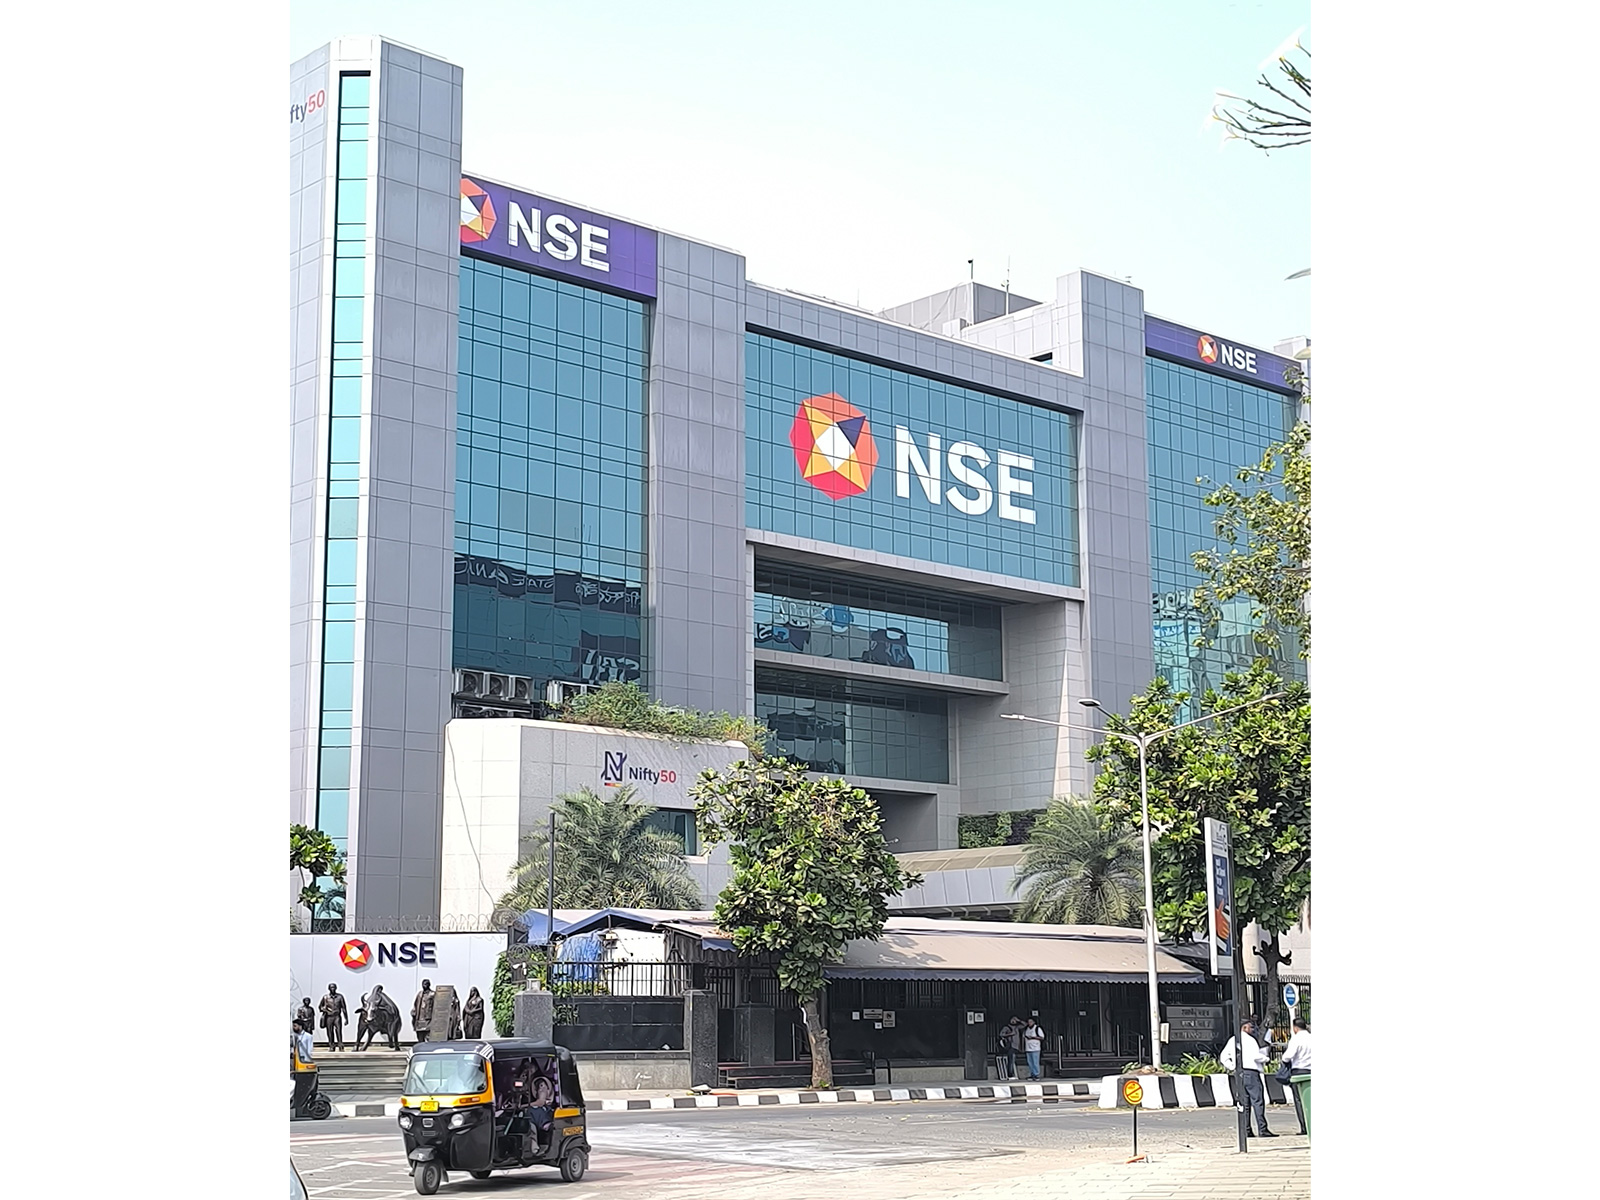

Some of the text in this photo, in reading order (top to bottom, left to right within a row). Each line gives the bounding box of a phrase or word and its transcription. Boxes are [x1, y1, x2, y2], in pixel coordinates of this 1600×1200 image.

[508, 201, 610, 272] NSE
[1221, 343, 1257, 374] NSE
[896, 425, 1037, 525] NSE
[629, 767, 677, 785] Nifty50
[378, 942, 437, 965] NSE
